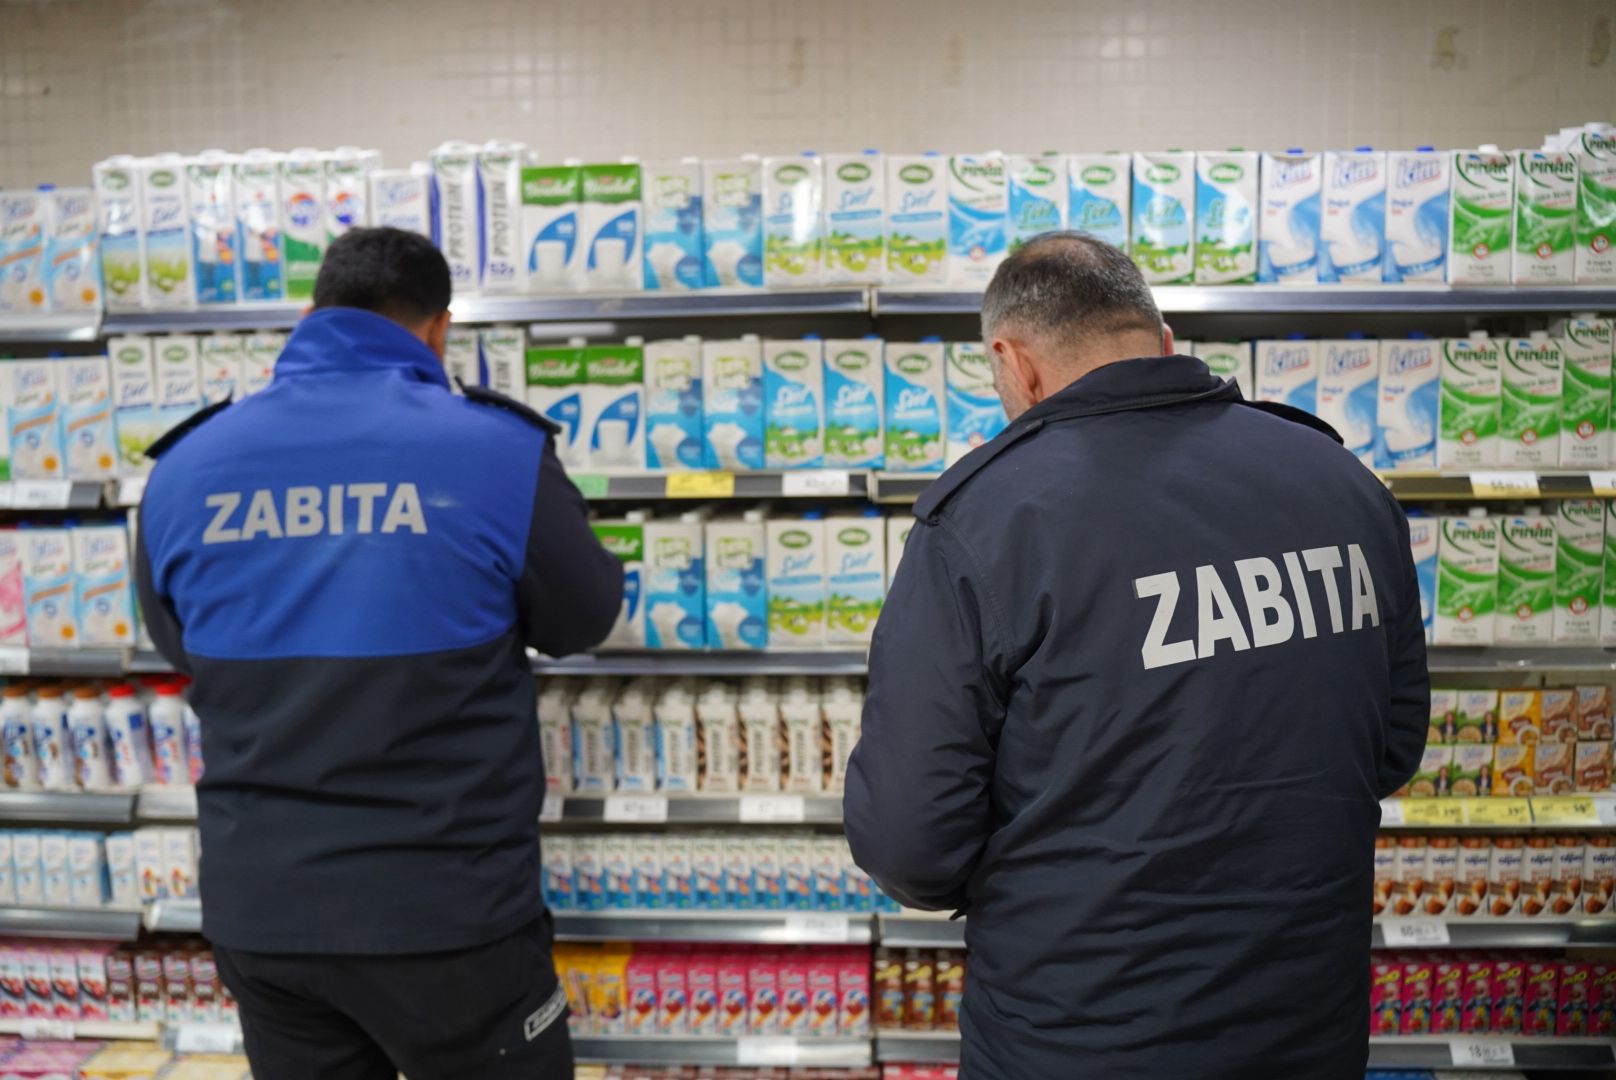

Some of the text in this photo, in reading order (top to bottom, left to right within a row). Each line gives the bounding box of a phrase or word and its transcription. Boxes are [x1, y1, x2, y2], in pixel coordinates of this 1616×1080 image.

[1589, 139, 1616, 150] PINA
[1465, 161, 1508, 175] PINAR
[1530, 160, 1574, 174] PINAR
[1575, 327, 1609, 337] PINAR
[1454, 350, 1497, 362] PINAR
[1515, 350, 1559, 362] PINAR
[203, 482, 428, 544] ZABITA
[1453, 529, 1496, 541] PINAR
[1510, 527, 1553, 539] PINAR
[1132, 543, 1380, 670] ZABITA
